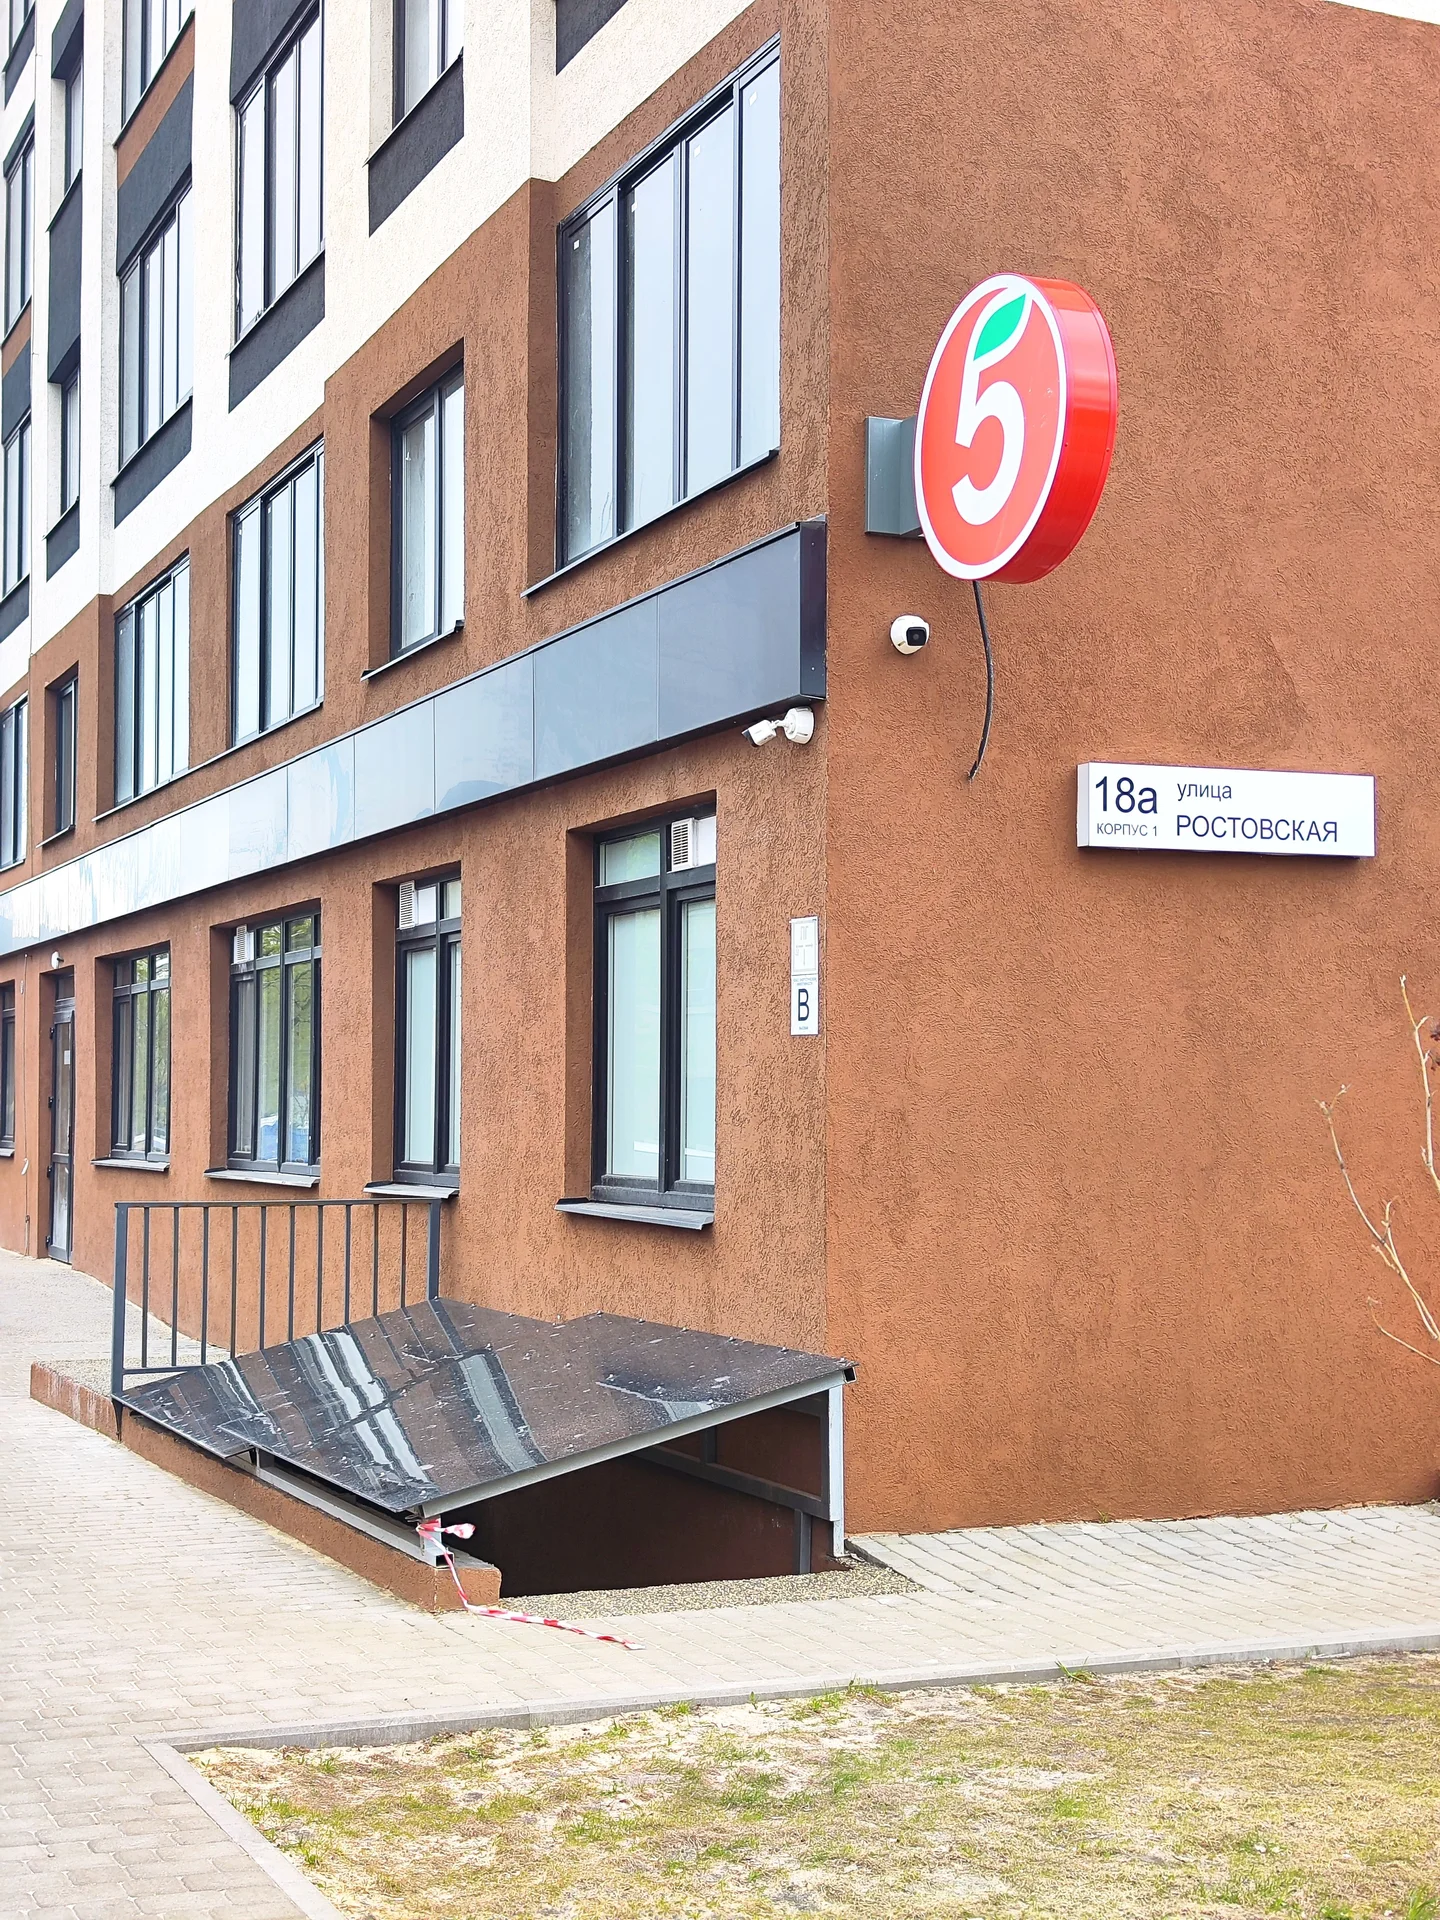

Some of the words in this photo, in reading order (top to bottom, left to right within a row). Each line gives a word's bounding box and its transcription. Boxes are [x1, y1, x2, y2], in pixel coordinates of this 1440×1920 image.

[951, 298, 1030, 526] 5
[1095, 775, 1158, 814] 18а
[1177, 782, 1232, 802] улица
[1096, 822, 1148, 837] КОРПУС
[1152, 825, 1158, 837] 1
[1176, 815, 1338, 843] РОСТОВСКАЯ
